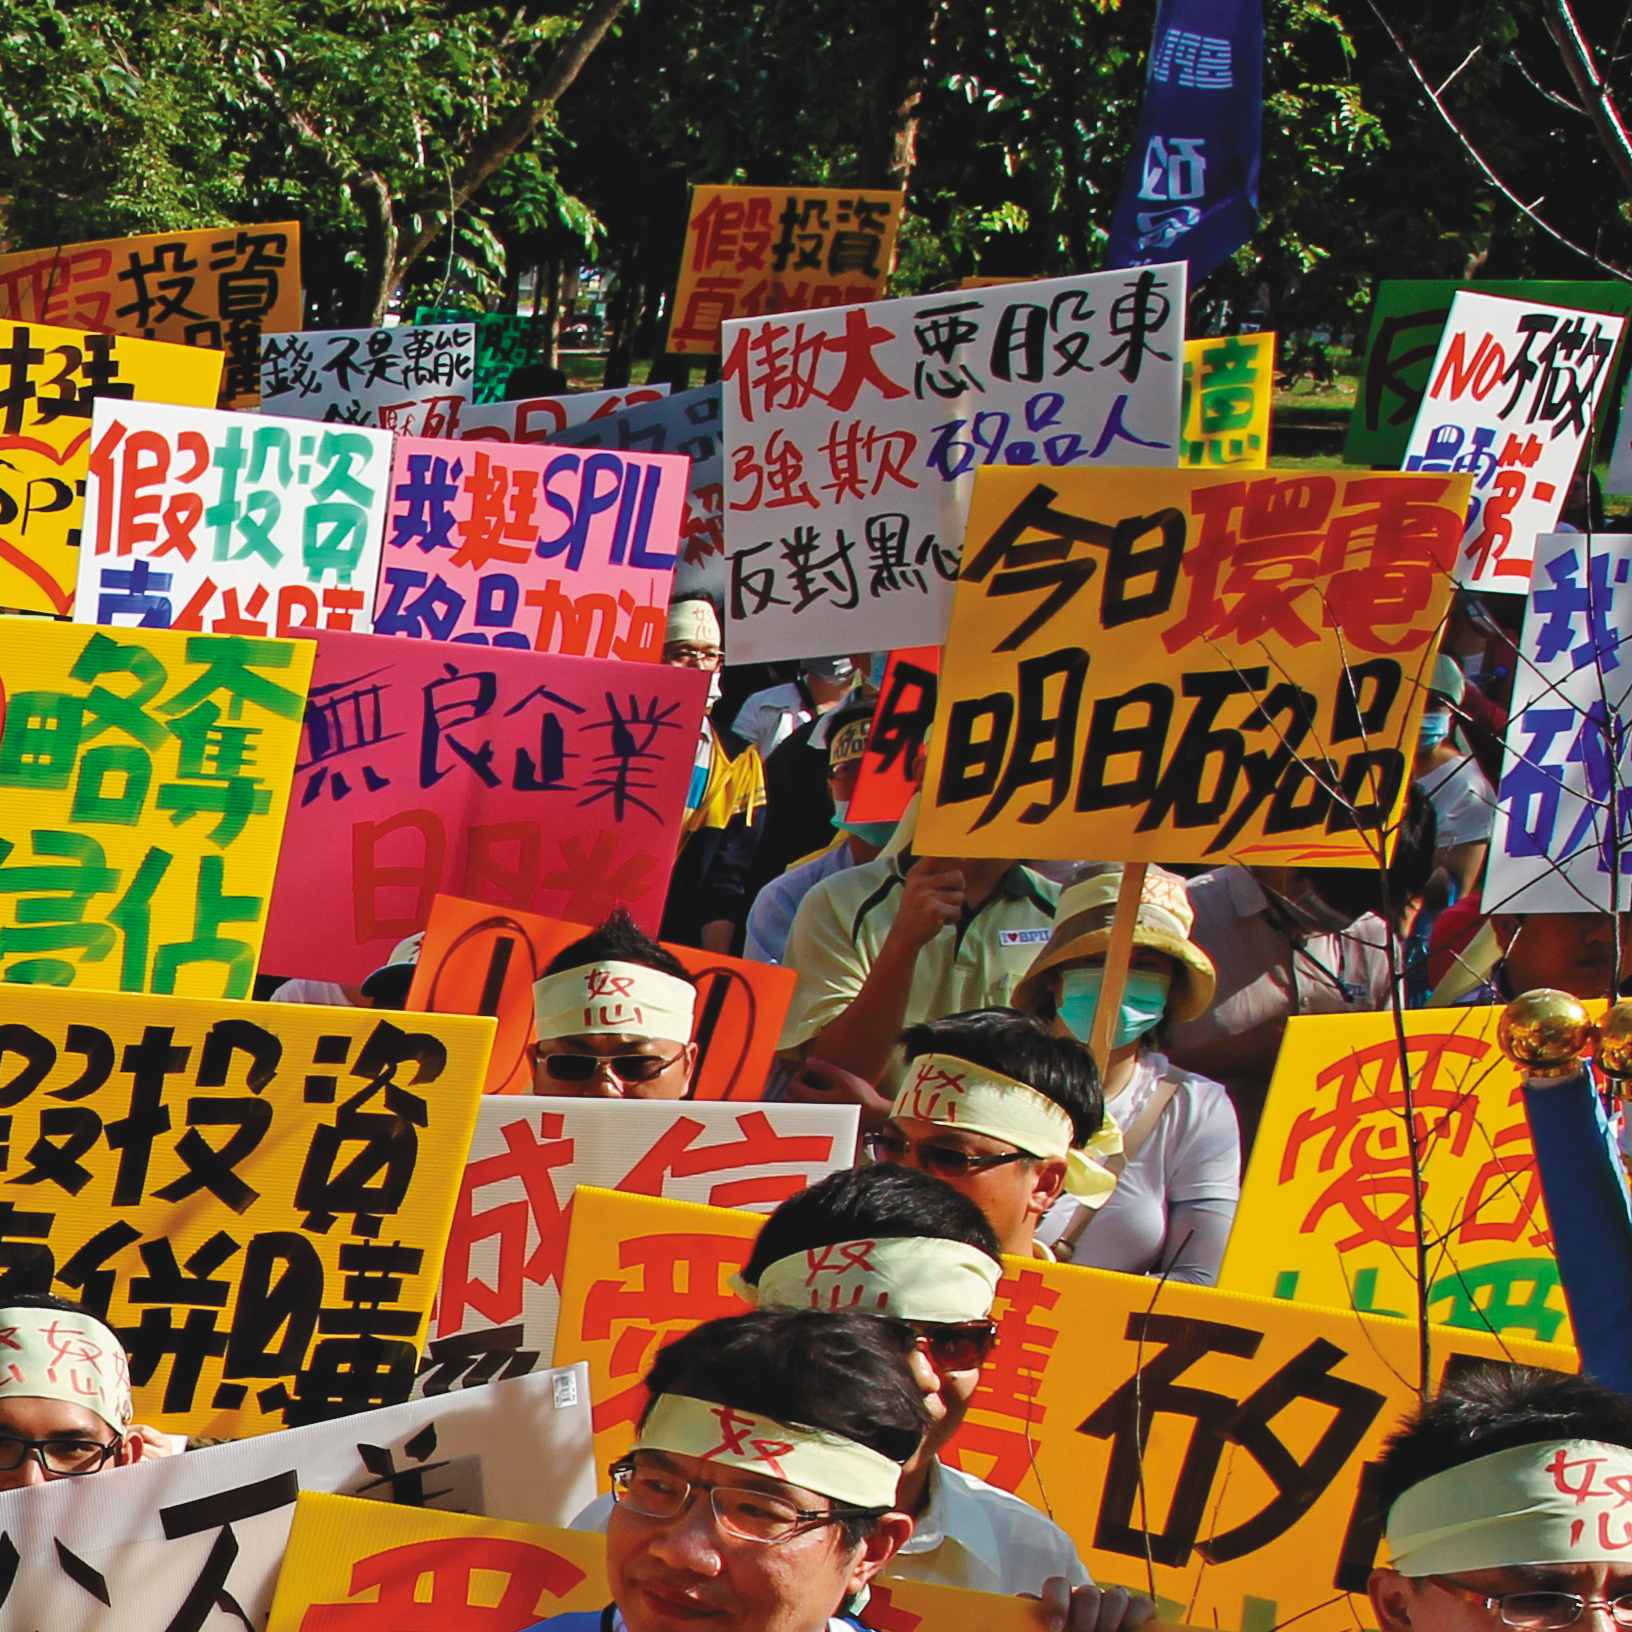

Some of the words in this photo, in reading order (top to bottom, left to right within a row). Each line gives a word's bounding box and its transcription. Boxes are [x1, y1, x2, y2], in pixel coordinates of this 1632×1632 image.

[691, 193, 892, 280] 假投資
[261, 327, 473, 399] 錢不是萬能
[87, 418, 375, 587] 假投資
[387, 451, 678, 572] 我挺SPIL
[958, 476, 1464, 654] 今日環電
[294, 661, 685, 827] 無良企業
[934, 648, 1407, 857] 明日矽品
[1496, 700, 1632, 875] 矽
